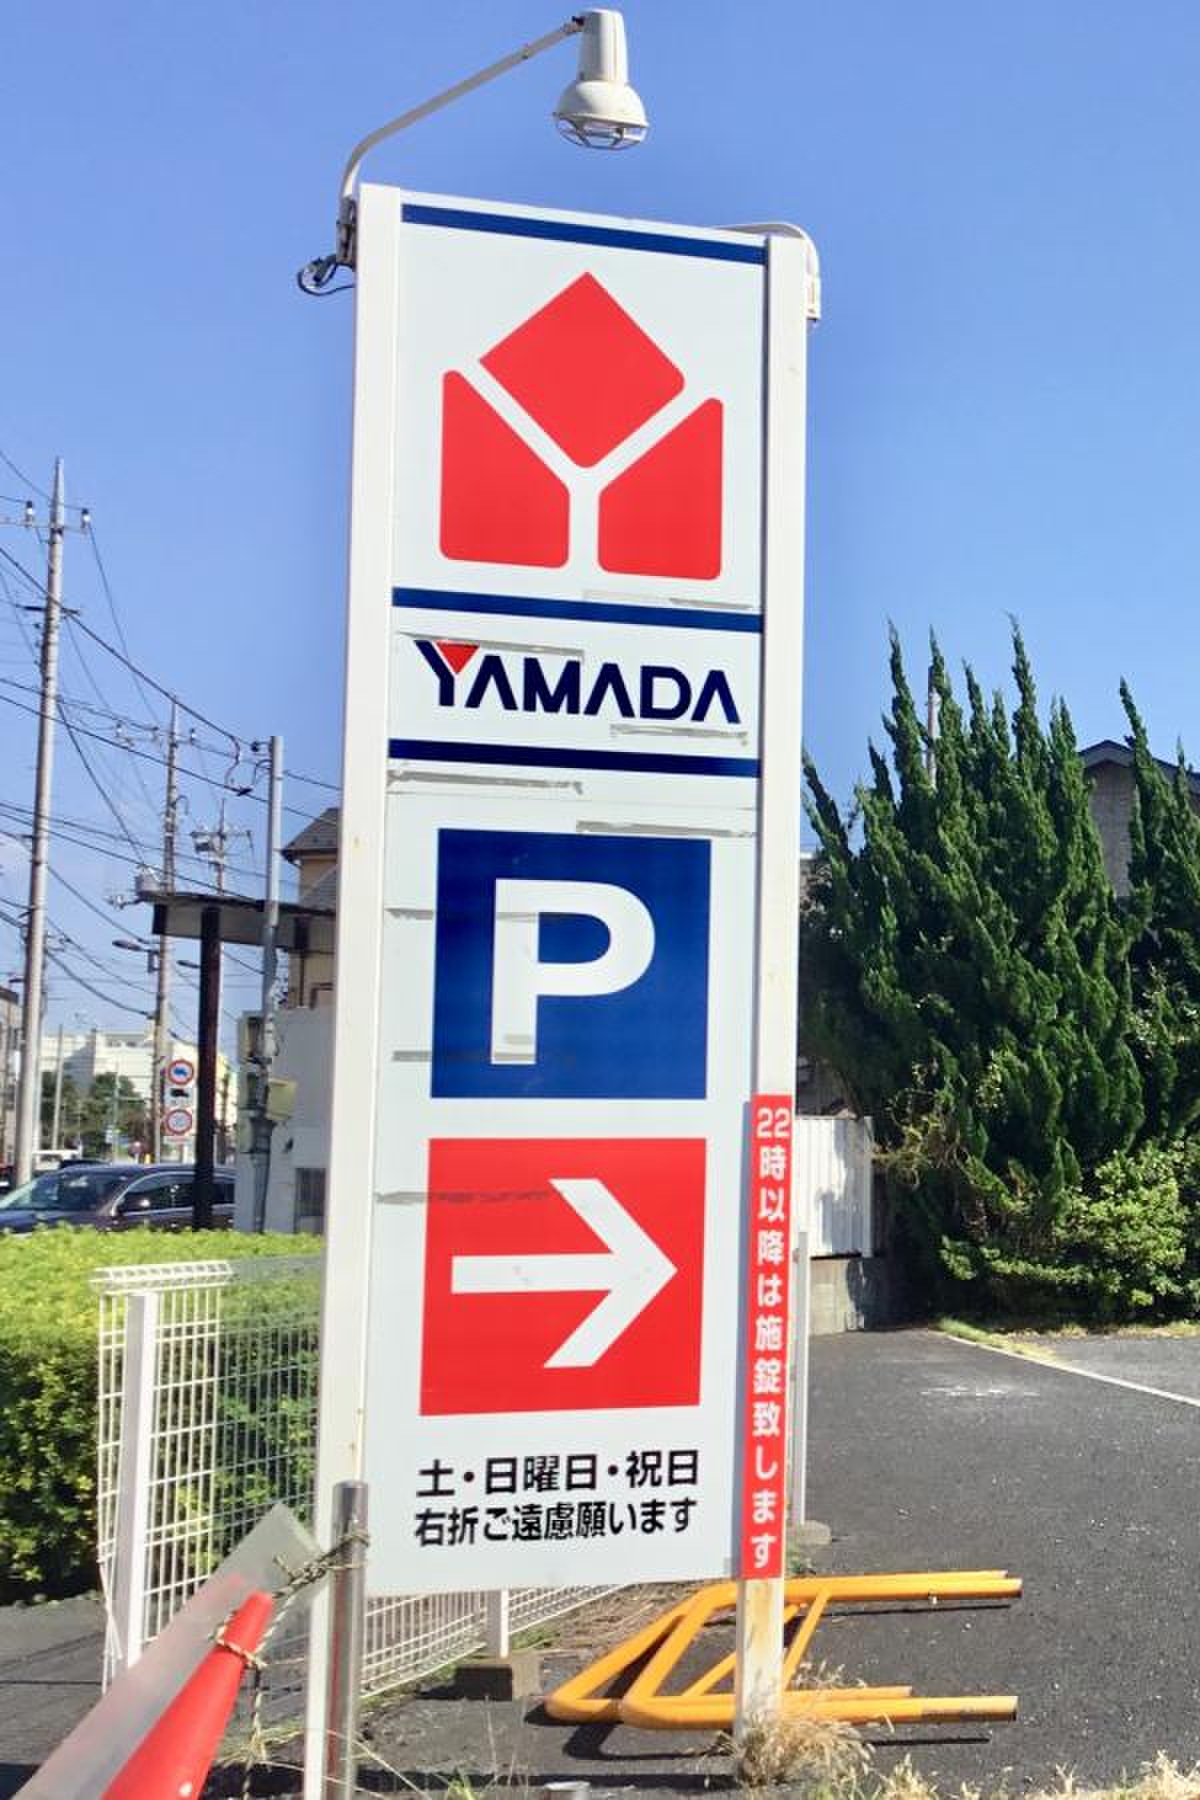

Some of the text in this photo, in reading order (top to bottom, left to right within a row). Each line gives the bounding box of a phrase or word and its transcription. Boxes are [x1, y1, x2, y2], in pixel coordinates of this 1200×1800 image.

[413, 639, 742, 724] YAMADA
[491, 878, 656, 1065] P
[751, 1107, 790, 1568] 22時以降は施錠致します
[416, 1450, 698, 1497] 土・日曜日・祝日
[415, 1497, 697, 1546] 右折ご遠慮願います
